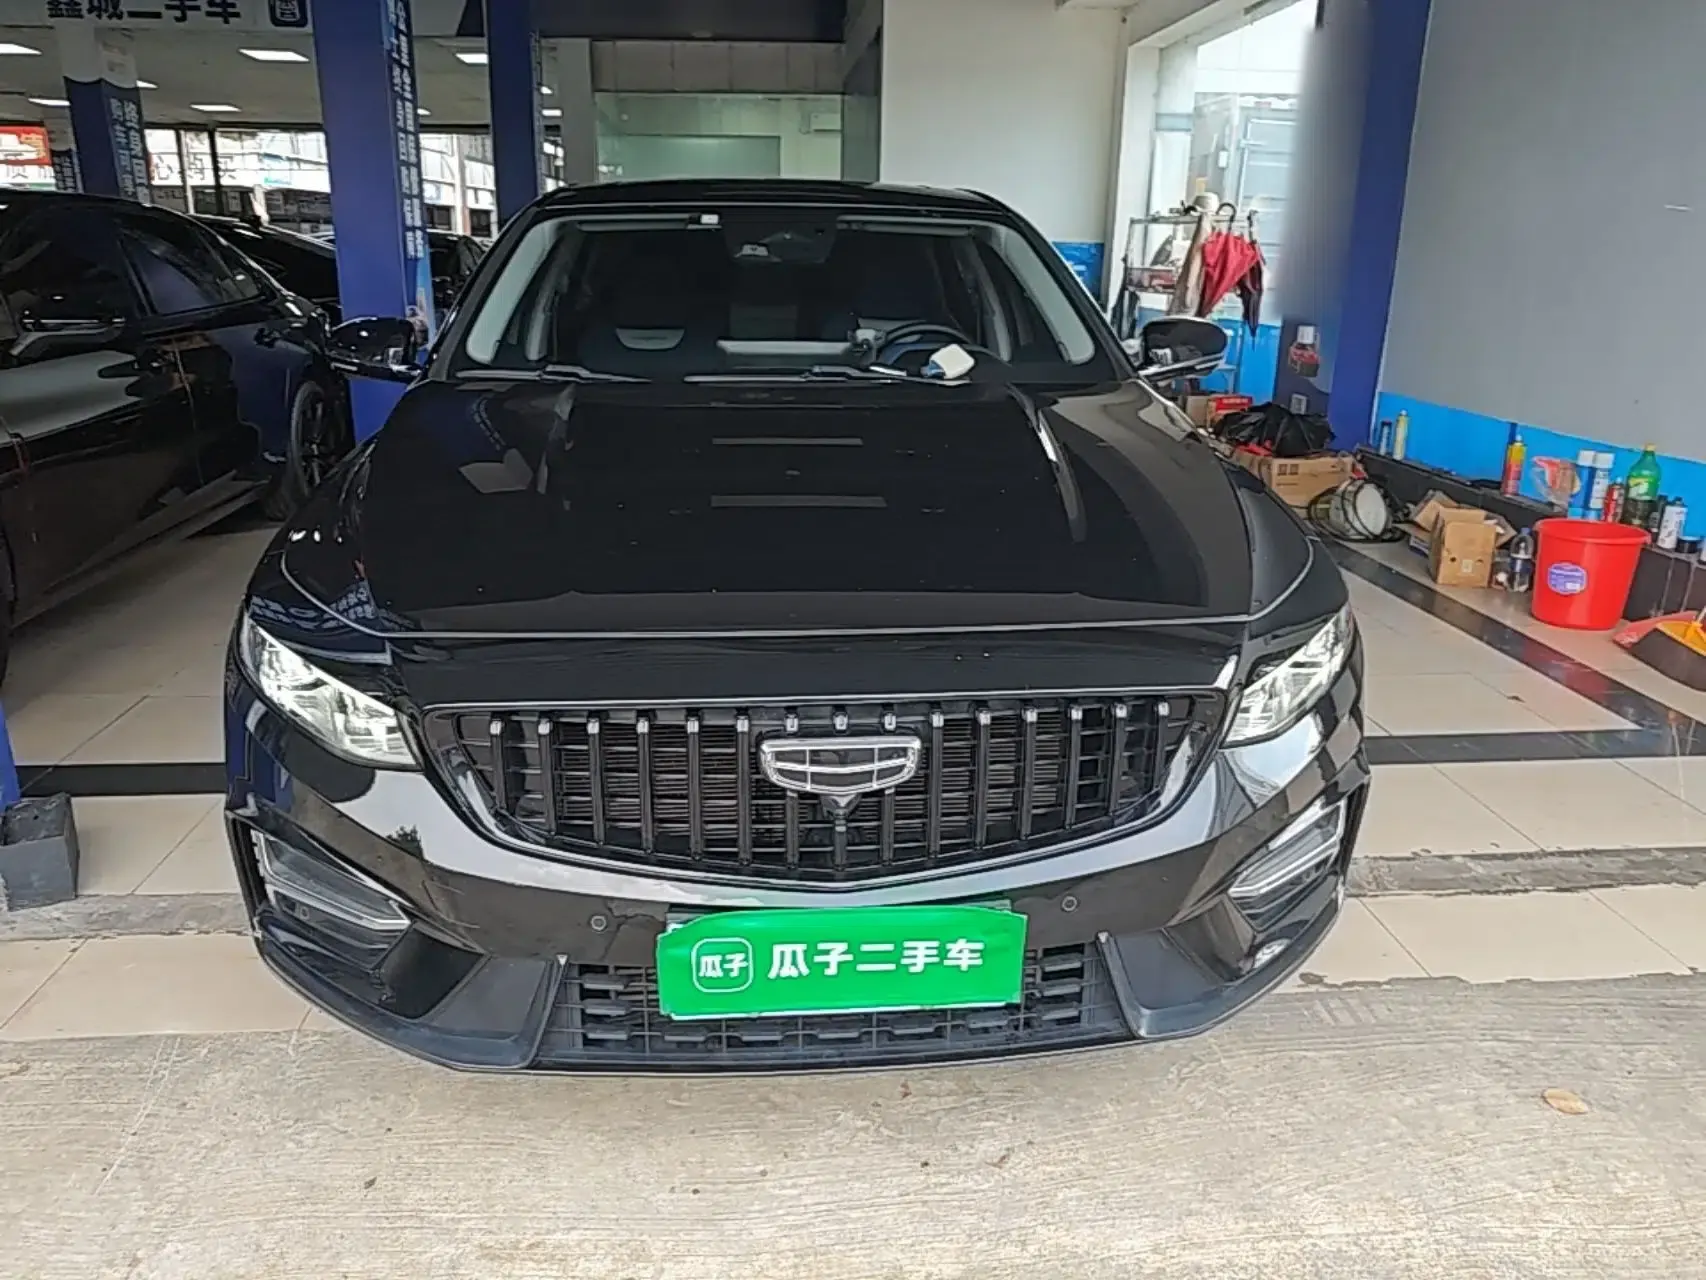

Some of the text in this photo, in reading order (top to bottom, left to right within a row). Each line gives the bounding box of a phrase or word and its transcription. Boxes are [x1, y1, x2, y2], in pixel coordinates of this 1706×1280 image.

[698, 952, 749, 979] 瓜子
[767, 939, 986, 980] 瓜子二手车
